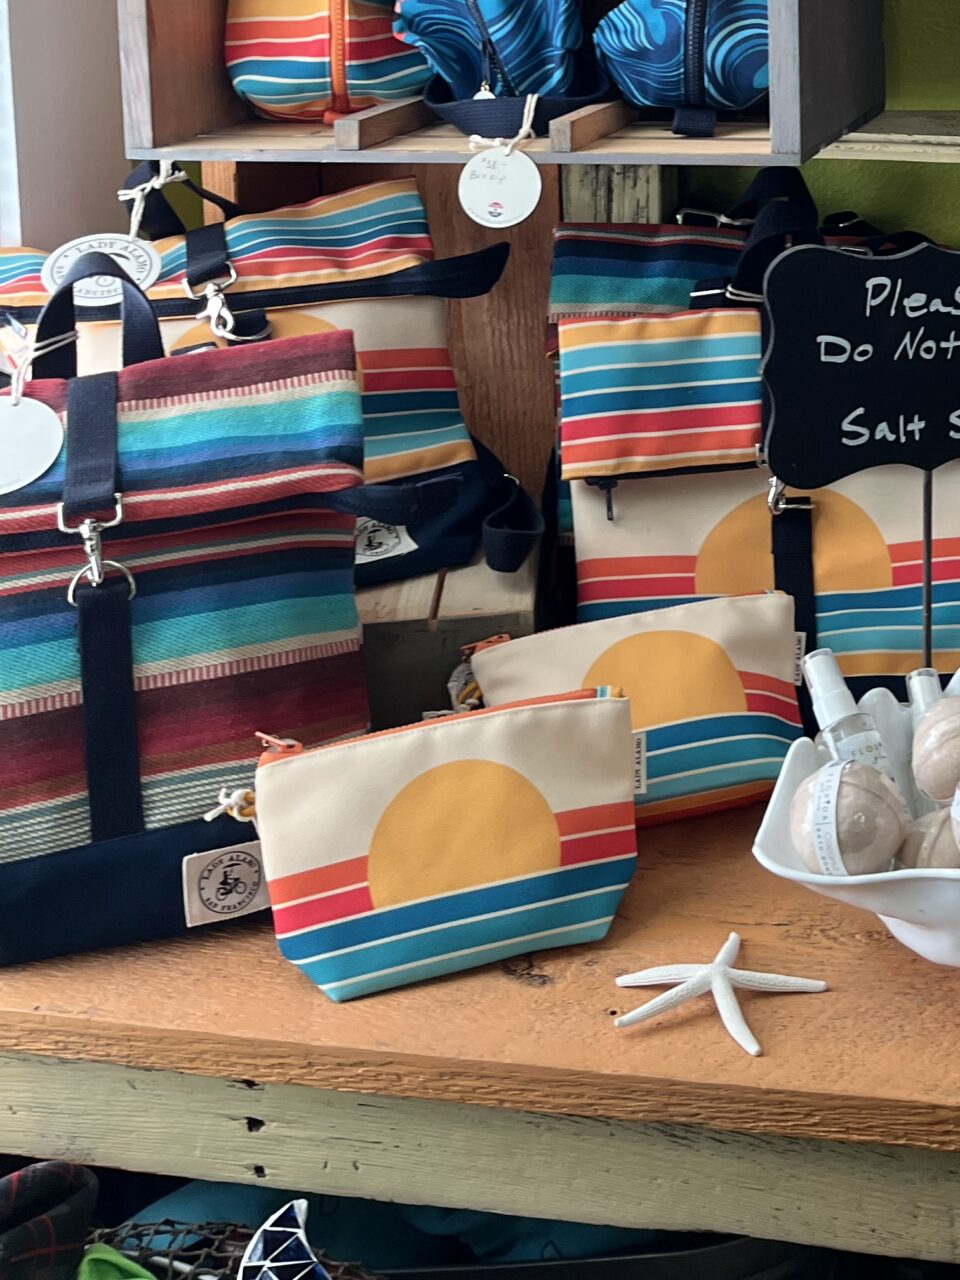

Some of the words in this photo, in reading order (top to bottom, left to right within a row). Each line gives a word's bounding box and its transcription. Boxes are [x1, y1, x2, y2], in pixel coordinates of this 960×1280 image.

[75, 241, 117, 254] LADY
[121, 244, 149, 274] ALAMO
[816, 334, 874, 364] Do
[841, 406, 926, 447] Salt
[202, 858, 224, 880] LADY
[228, 854, 257, 869] ALAMO
[205, 896, 219, 909] SAN
[220, 880, 260, 911] FRANCISCO
